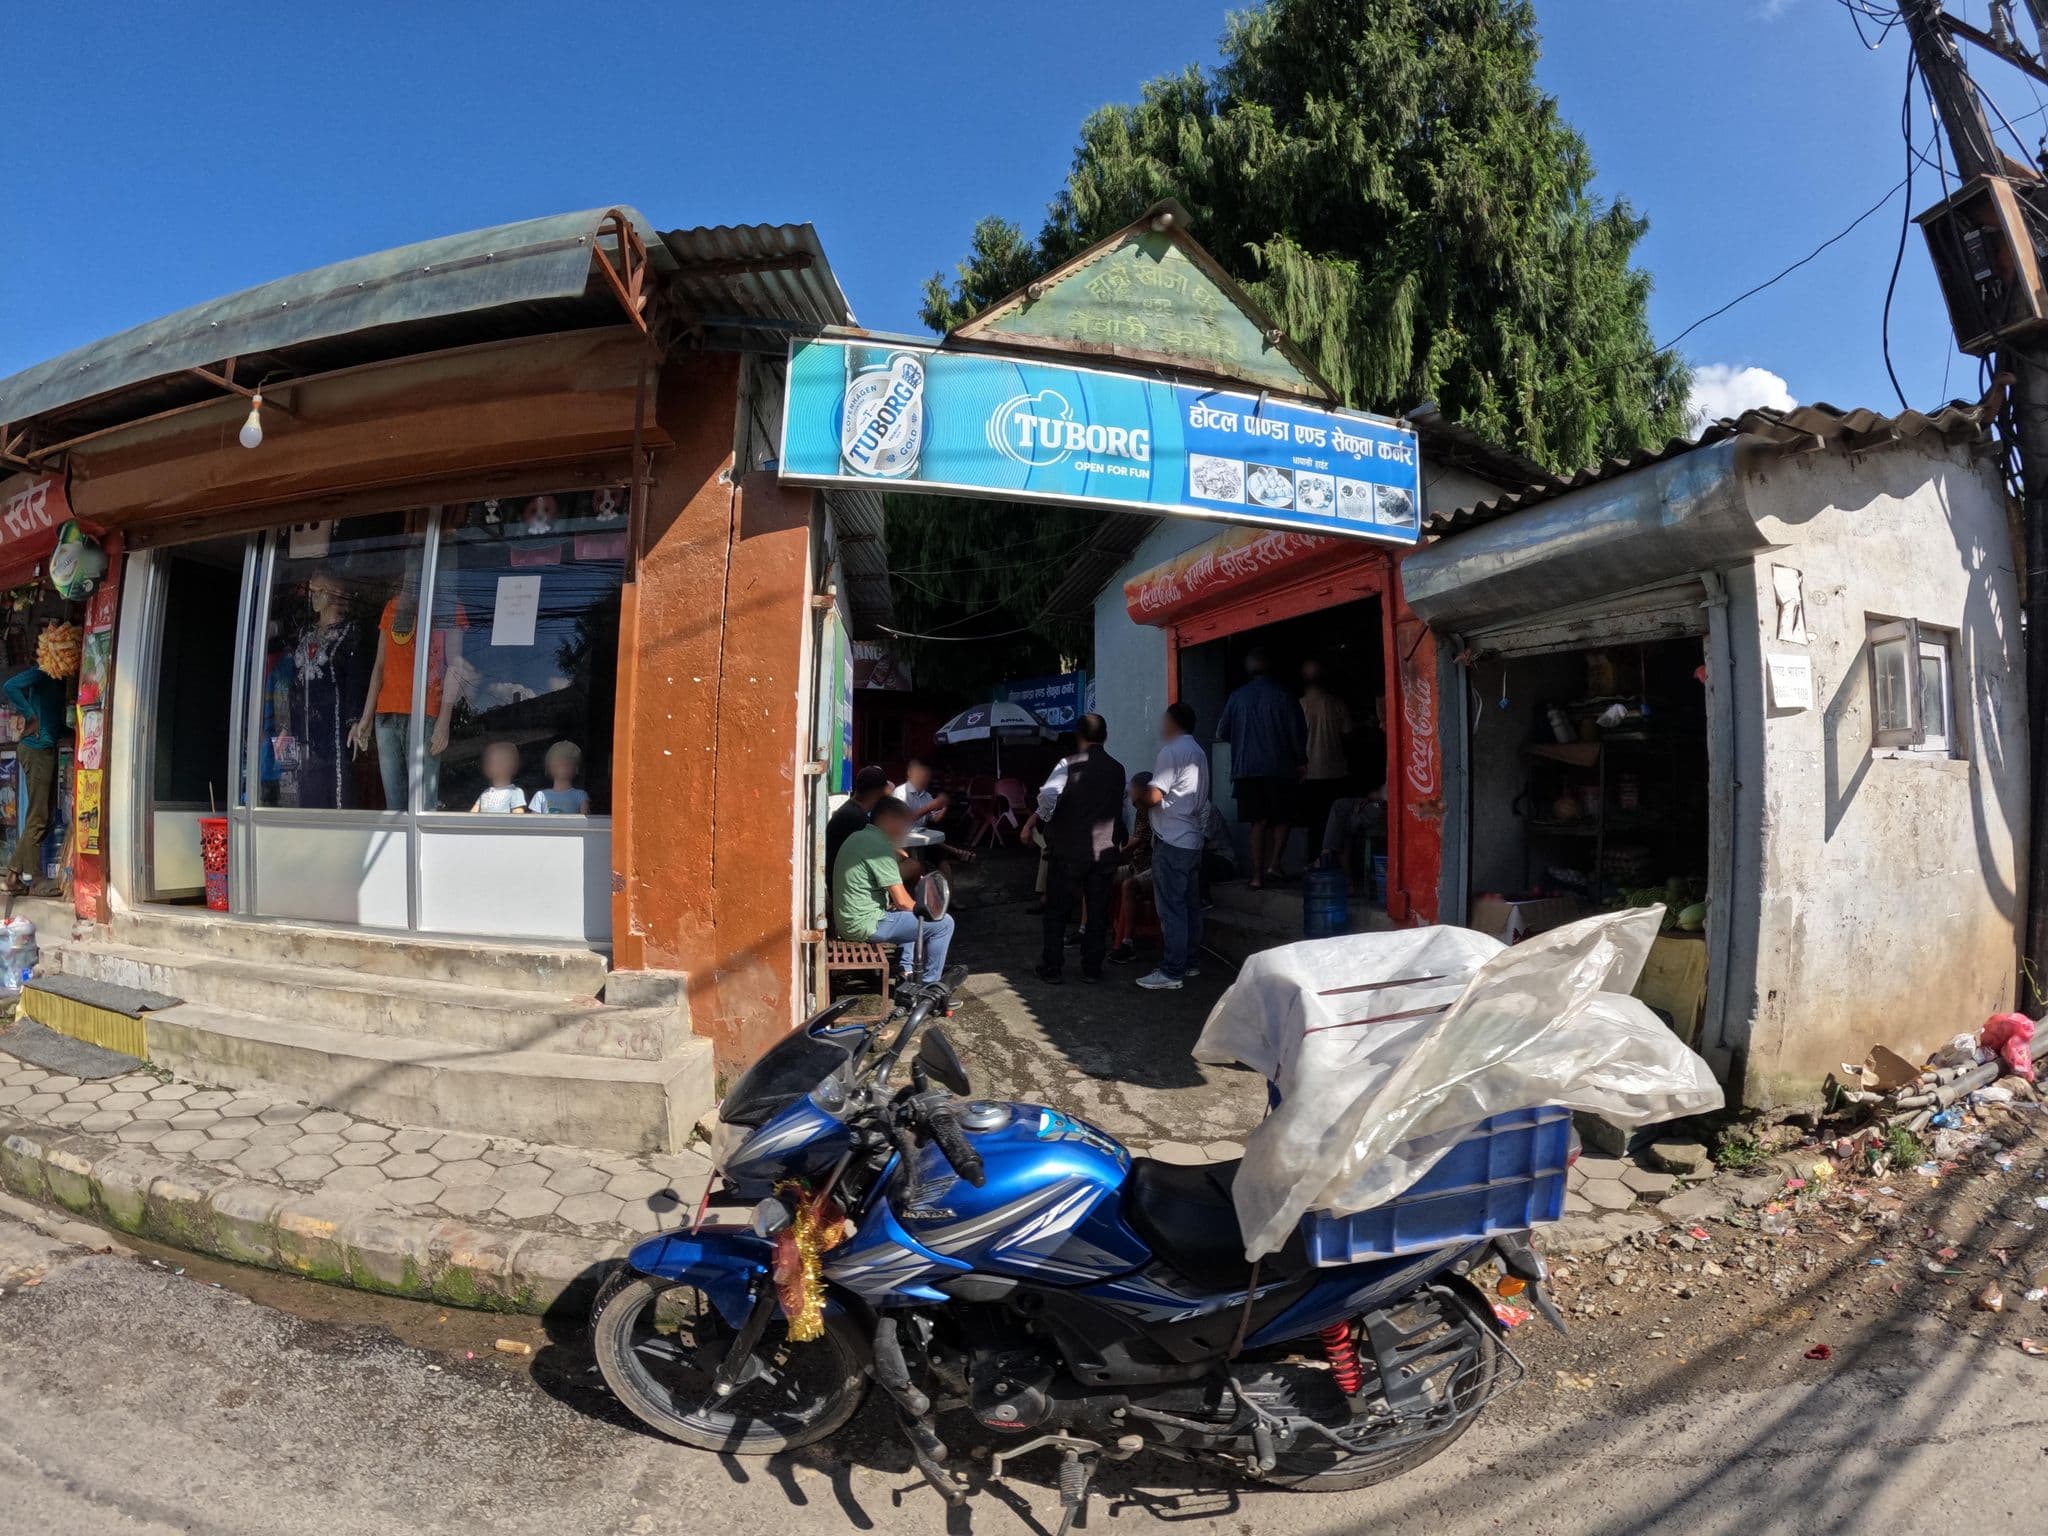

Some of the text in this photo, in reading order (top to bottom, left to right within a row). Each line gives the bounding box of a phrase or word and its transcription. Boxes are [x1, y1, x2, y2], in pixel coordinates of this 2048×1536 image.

[846, 384, 878, 433] COPENHAGEN
[849, 380, 915, 465] TUBORG
[1189, 400, 1238, 433] होटल
[1294, 423, 1327, 448] एण्ड
[1331, 426, 1373, 460] सेकुवा
[1377, 440, 1414, 466] कर्नर
[900, 429, 918, 456] GOLD
[1014, 412, 1150, 463] TUBORG
[1074, 461, 1150, 480] OPEN FOR FUN
[4, 479, 53, 538] स्टोर
[1218, 545, 1260, 579] कोल्ड
[1254, 529, 1295, 566] स्टोर
